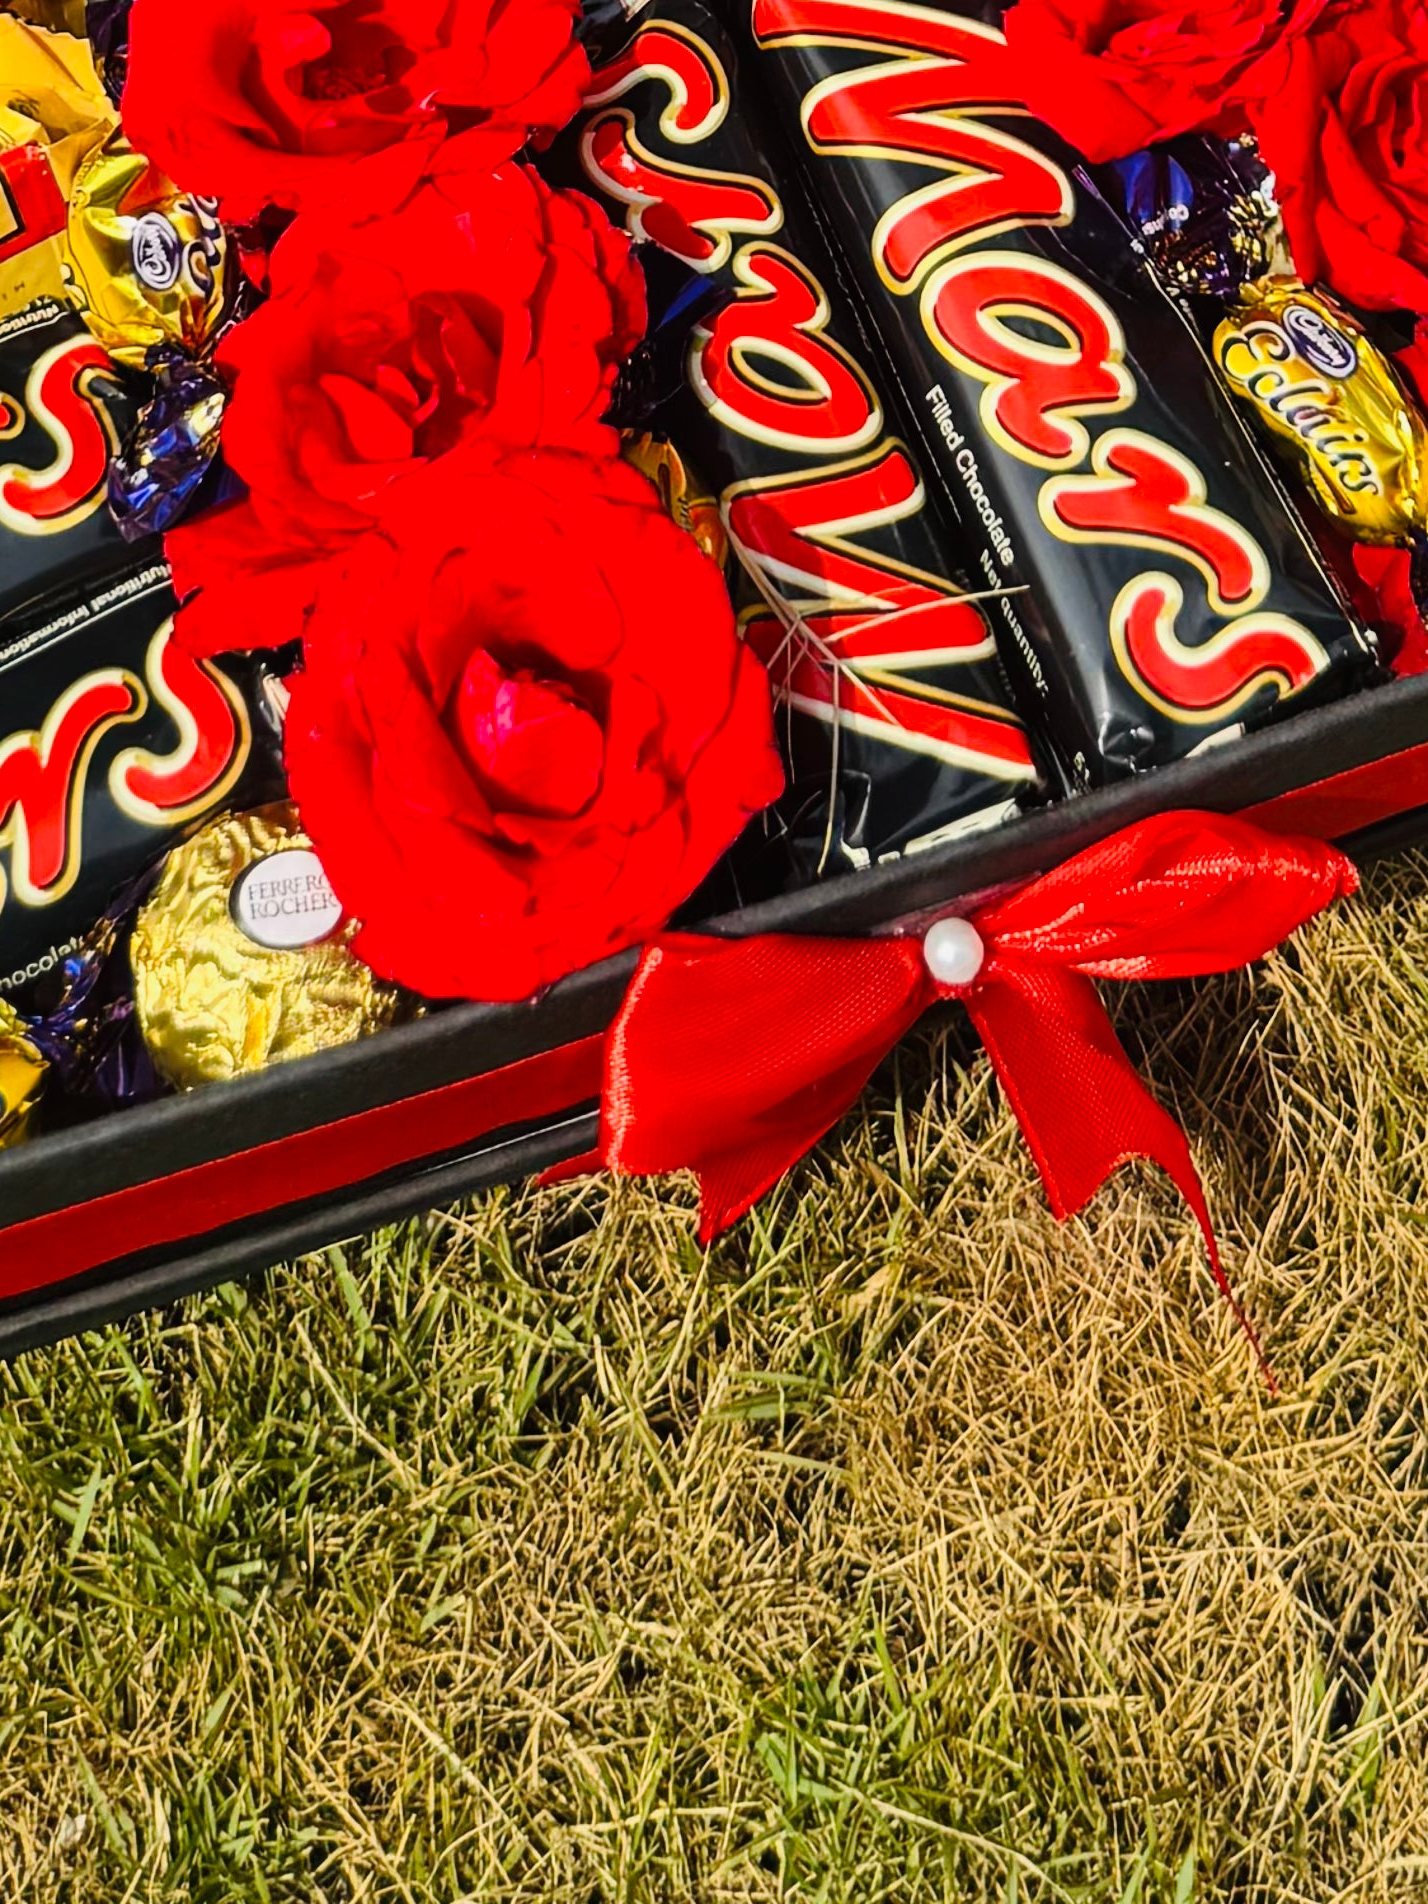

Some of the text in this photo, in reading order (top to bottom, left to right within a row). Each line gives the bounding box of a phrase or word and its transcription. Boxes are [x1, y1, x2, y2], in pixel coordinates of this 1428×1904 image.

[579, 17, 1040, 785] Mars
[925, 383, 1016, 568] Filled Chocolate
[1220, 320, 1380, 498] Eclairs
[250, 893, 338, 920] ROCHER
